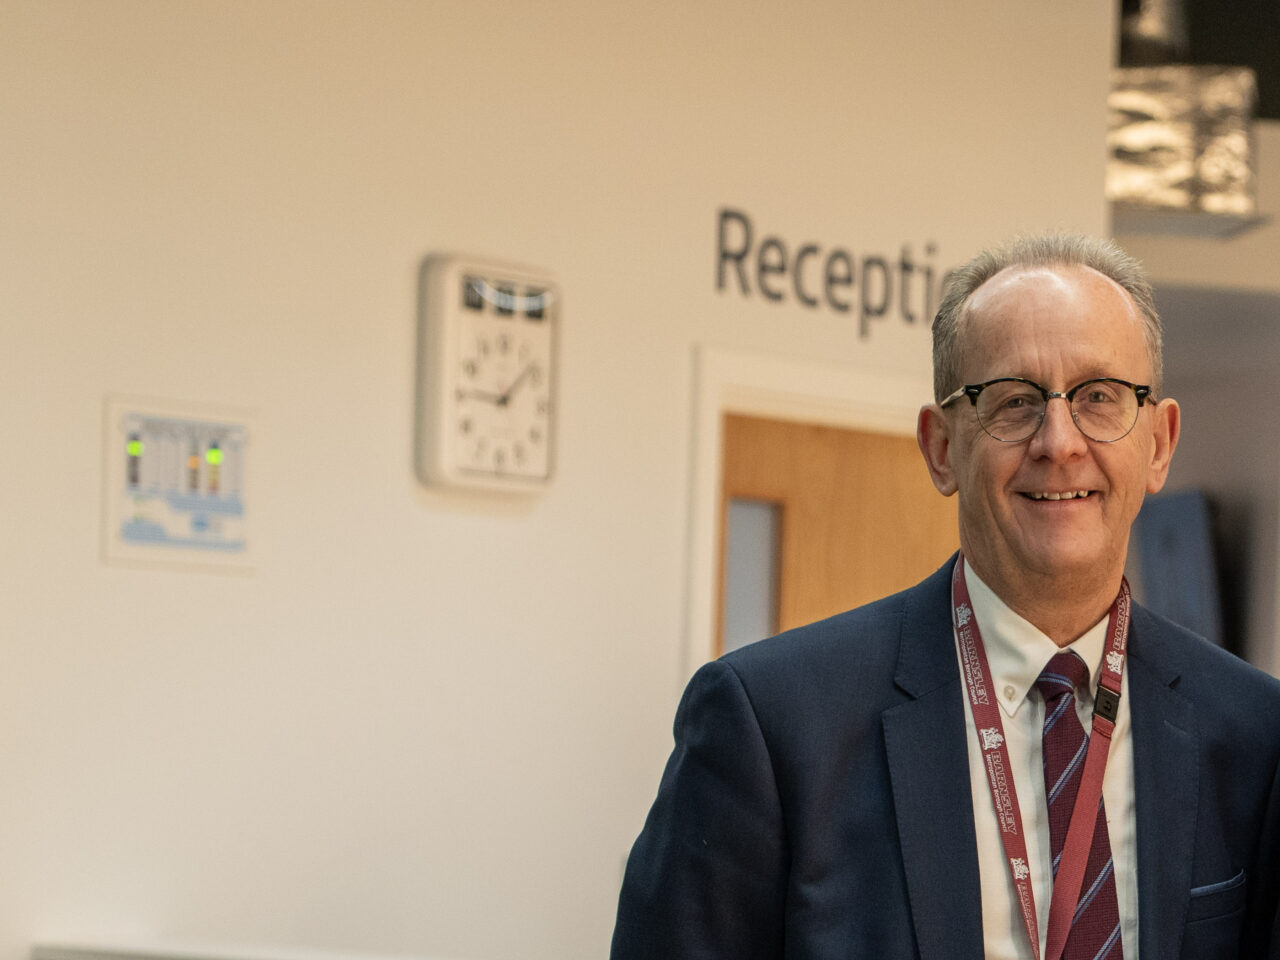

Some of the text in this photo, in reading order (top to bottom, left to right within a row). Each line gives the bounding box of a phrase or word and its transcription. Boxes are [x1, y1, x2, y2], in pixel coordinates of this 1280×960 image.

[714, 205, 955, 342] Recepti
[962, 625, 989, 706] BARNSLEY
[986, 753, 1008, 833] Metropolitan Borough Council
[990, 750, 1017, 835] BARNSLEY
